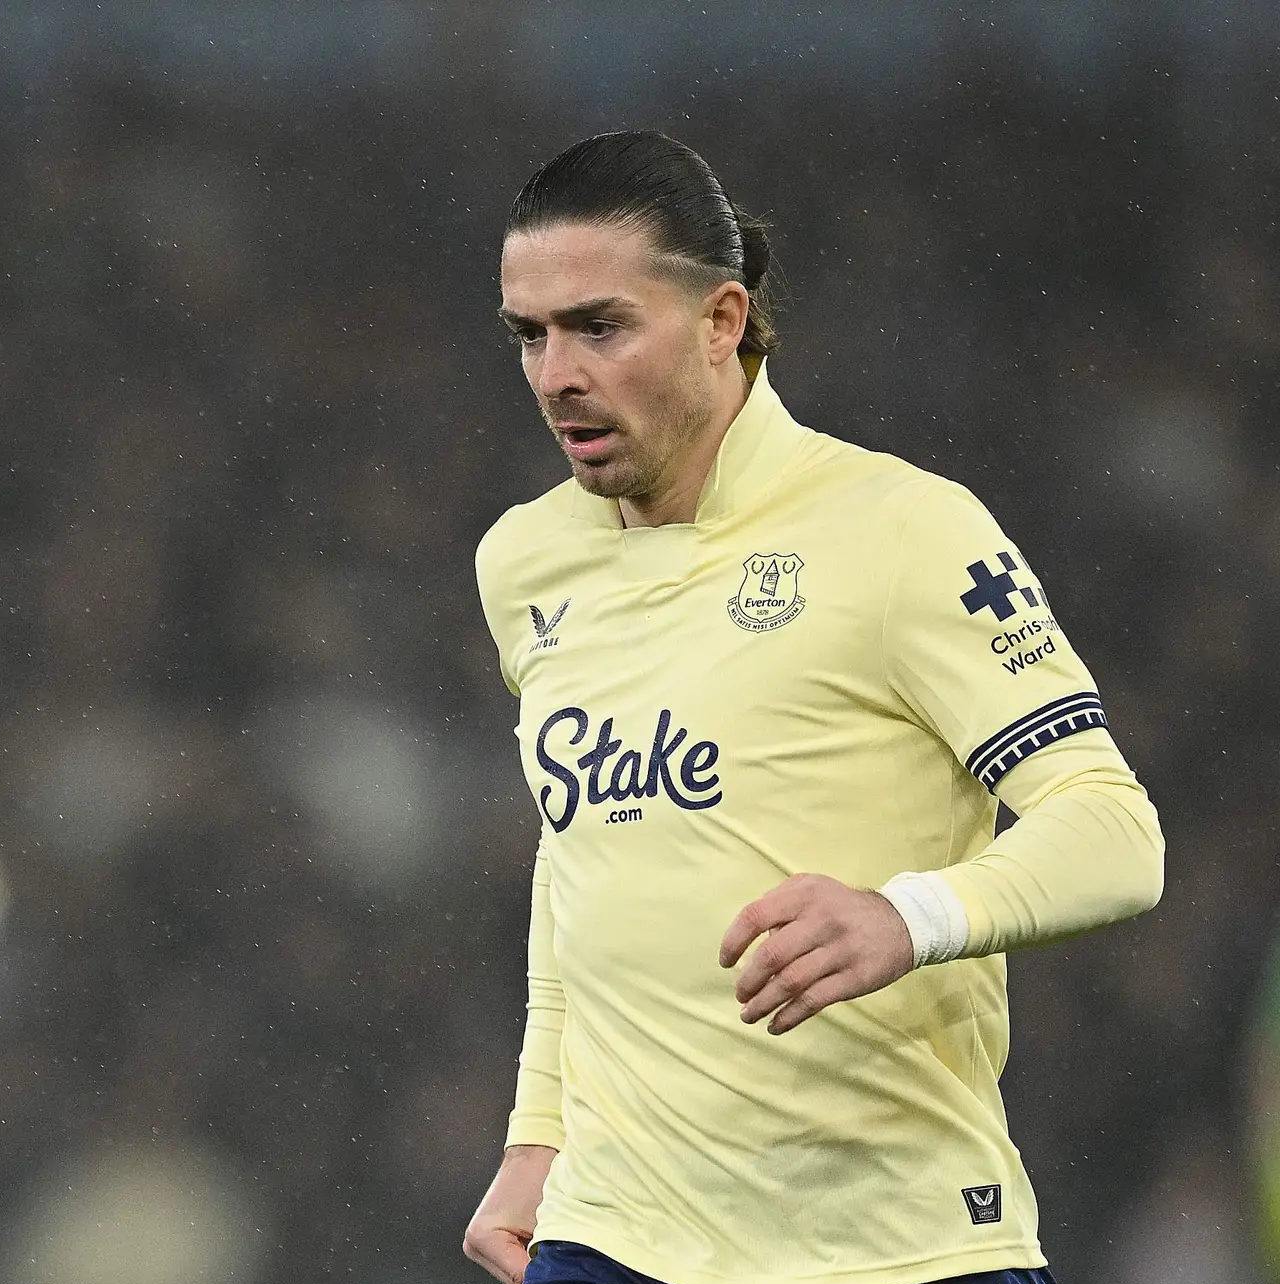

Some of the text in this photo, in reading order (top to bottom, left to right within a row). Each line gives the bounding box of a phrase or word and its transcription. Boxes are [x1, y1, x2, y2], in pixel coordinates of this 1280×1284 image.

[745, 597, 786, 608] Everton
[736, 617, 751, 629] SATIS
[769, 607, 800, 627] OPTIMUM
[1001, 635, 1056, 675] Ward
[536, 707, 723, 833] Stake
[605, 807, 643, 824] .com
